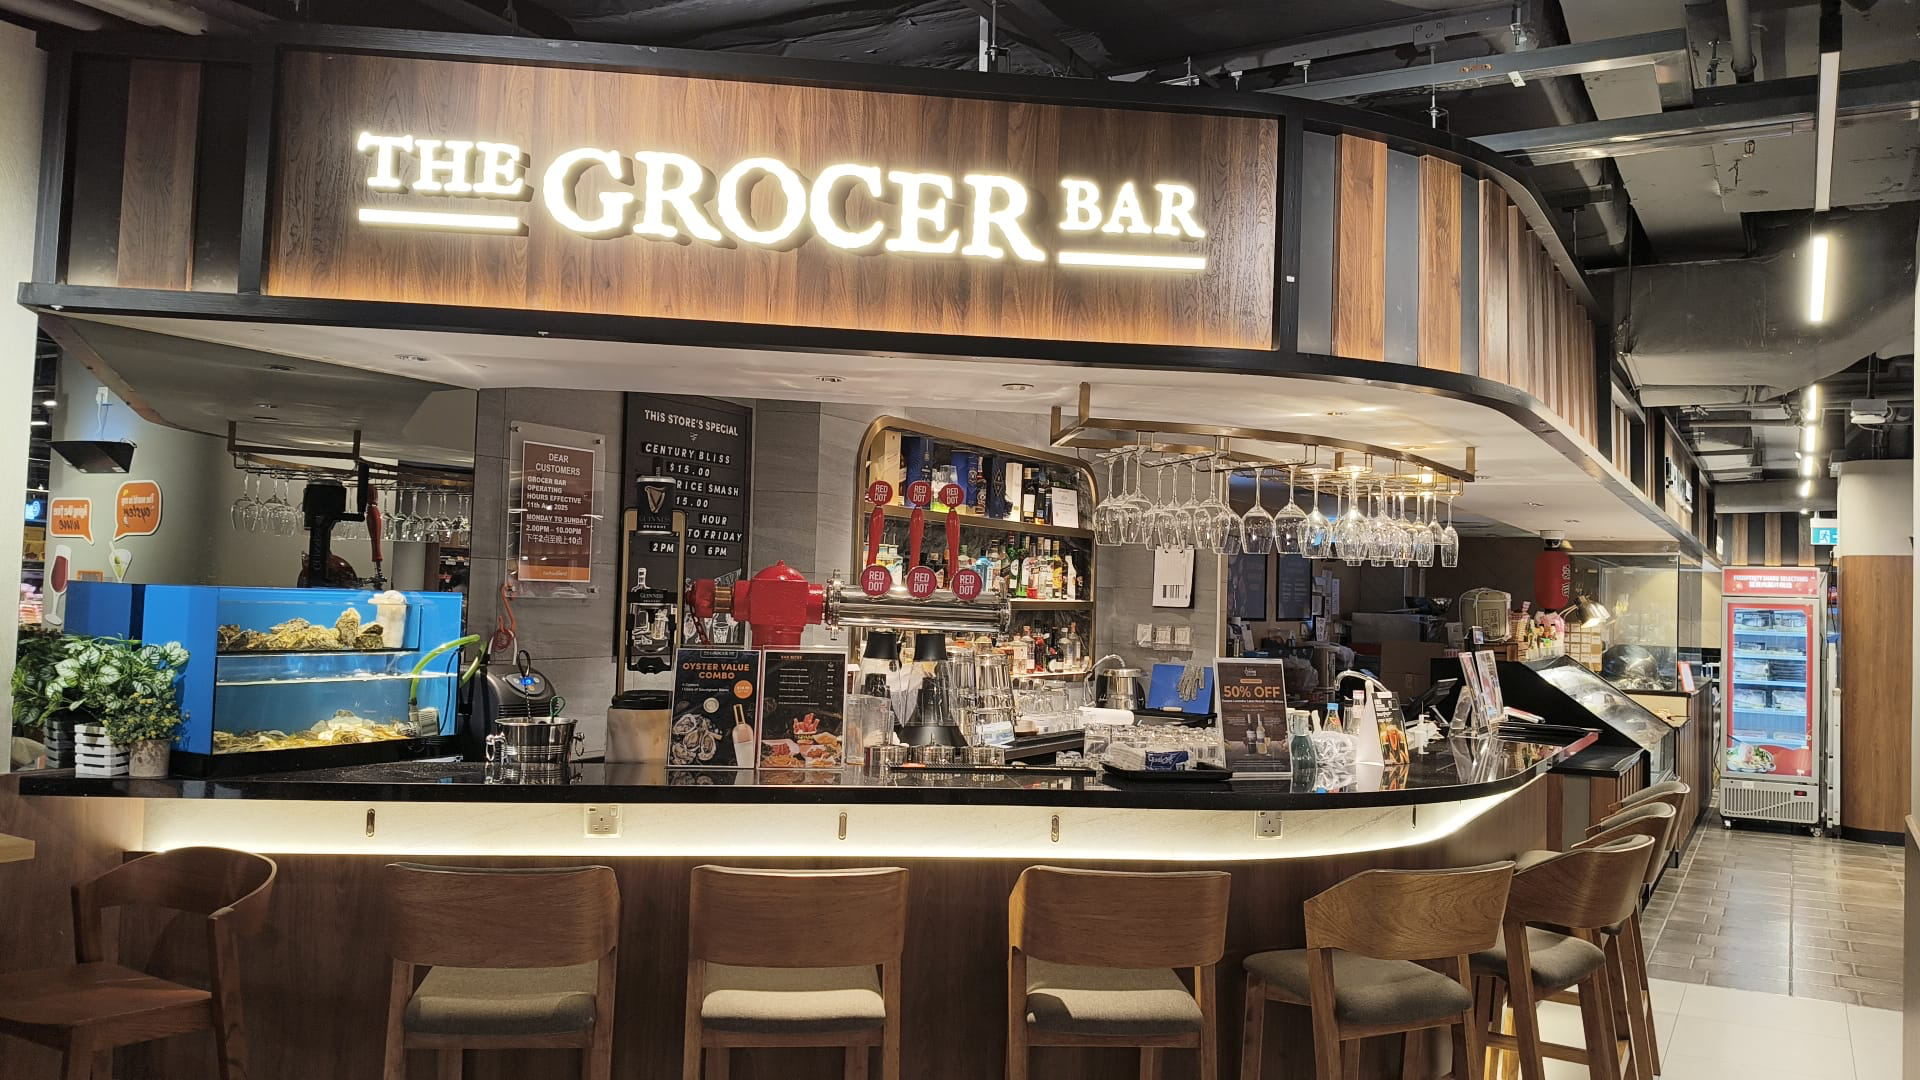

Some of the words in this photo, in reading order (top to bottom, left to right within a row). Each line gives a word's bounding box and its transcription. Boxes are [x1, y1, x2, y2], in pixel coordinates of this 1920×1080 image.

[357, 131, 524, 195] THE
[542, 146, 1046, 262] GROCER
[1059, 178, 1206, 238] BAR
[644, 409, 666, 423] THIS
[667, 414, 704, 430] STORE'S
[705, 421, 739, 437] SPECIAL
[548, 453, 569, 463] DEAR
[645, 443, 695, 459] CENTURY
[698, 451, 730, 464] BLISS
[535, 462, 581, 476] CUSTOMERS
[669, 462, 711, 477] $15.00
[527, 475, 553, 485] GROCER
[527, 484, 563, 494] OPERATING
[676, 480, 703, 492] RICE
[708, 483, 739, 496] SMASH
[875, 484, 889, 493] RED
[914, 485, 927, 494] RED
[946, 487, 959, 496] RED
[526, 492, 549, 501] HOURS
[550, 494, 582, 504] EFFECTIVE
[874, 493, 888, 502] DOT
[913, 494, 926, 503] DOT
[946, 496, 958, 505] DOT
[526, 501, 541, 509] 11th
[554, 503, 569, 511] 2025
[526, 513, 553, 522] MONDAY
[563, 516, 588, 525] SUNDAY
[701, 514, 728, 526] HOUR
[525, 524, 549, 533] 2.00PM
[556, 526, 582, 535] 10.00PM
[687, 528, 700, 539] TO
[704, 530, 743, 543] FRIDAY
[869, 570, 885, 581] RED
[914, 572, 930, 583] RED
[959, 574, 975, 585] RED
[868, 581, 884, 592] DOT
[913, 583, 929, 593] DOT
[959, 585, 975, 596] DOT
[682, 663, 719, 671] OYSTER
[721, 664, 750, 672] VALUE
[1224, 686, 1251, 698] 50%
[1254, 686, 1280, 698] OFF
